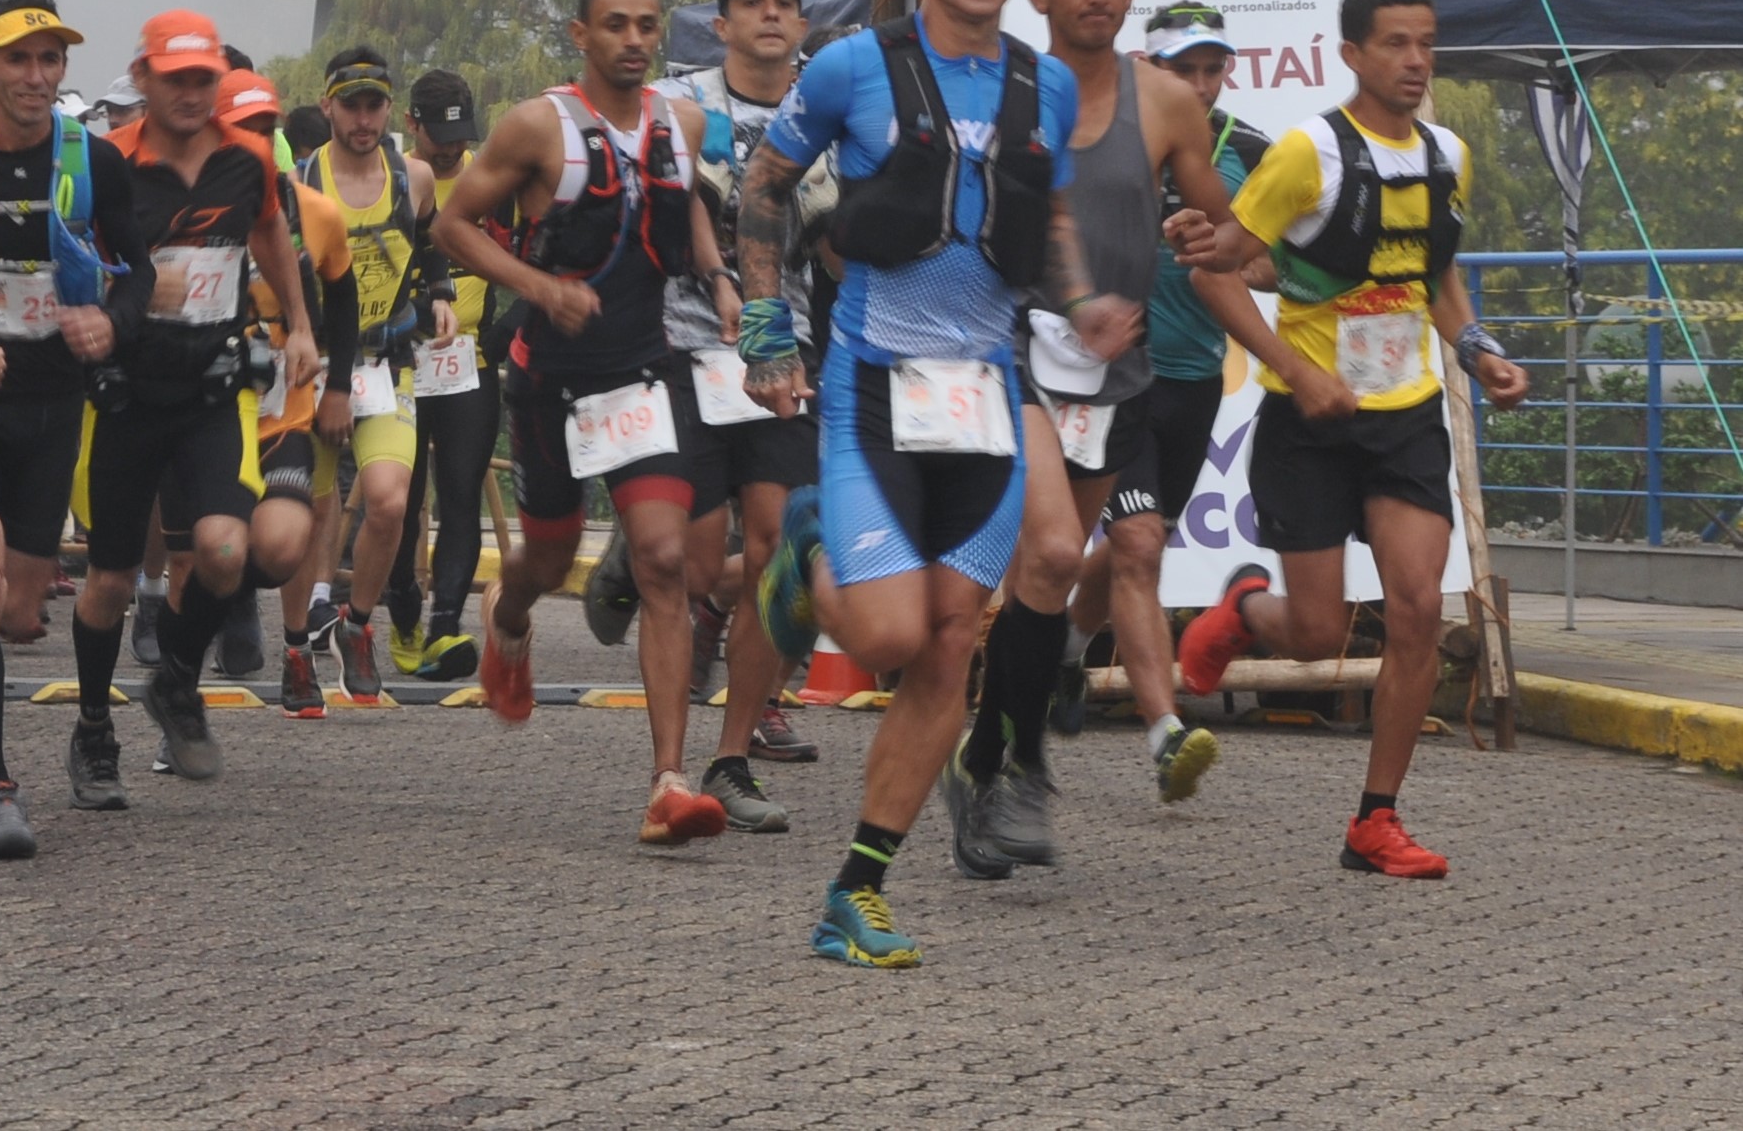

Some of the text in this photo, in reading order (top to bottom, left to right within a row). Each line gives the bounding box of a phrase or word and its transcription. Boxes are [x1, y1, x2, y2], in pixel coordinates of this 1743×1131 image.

[1221, 1, 1317, 15] personalizados
[432, 355, 460, 377] 75
[598, 405, 654, 444] 109
[1118, 488, 1157, 514] life
